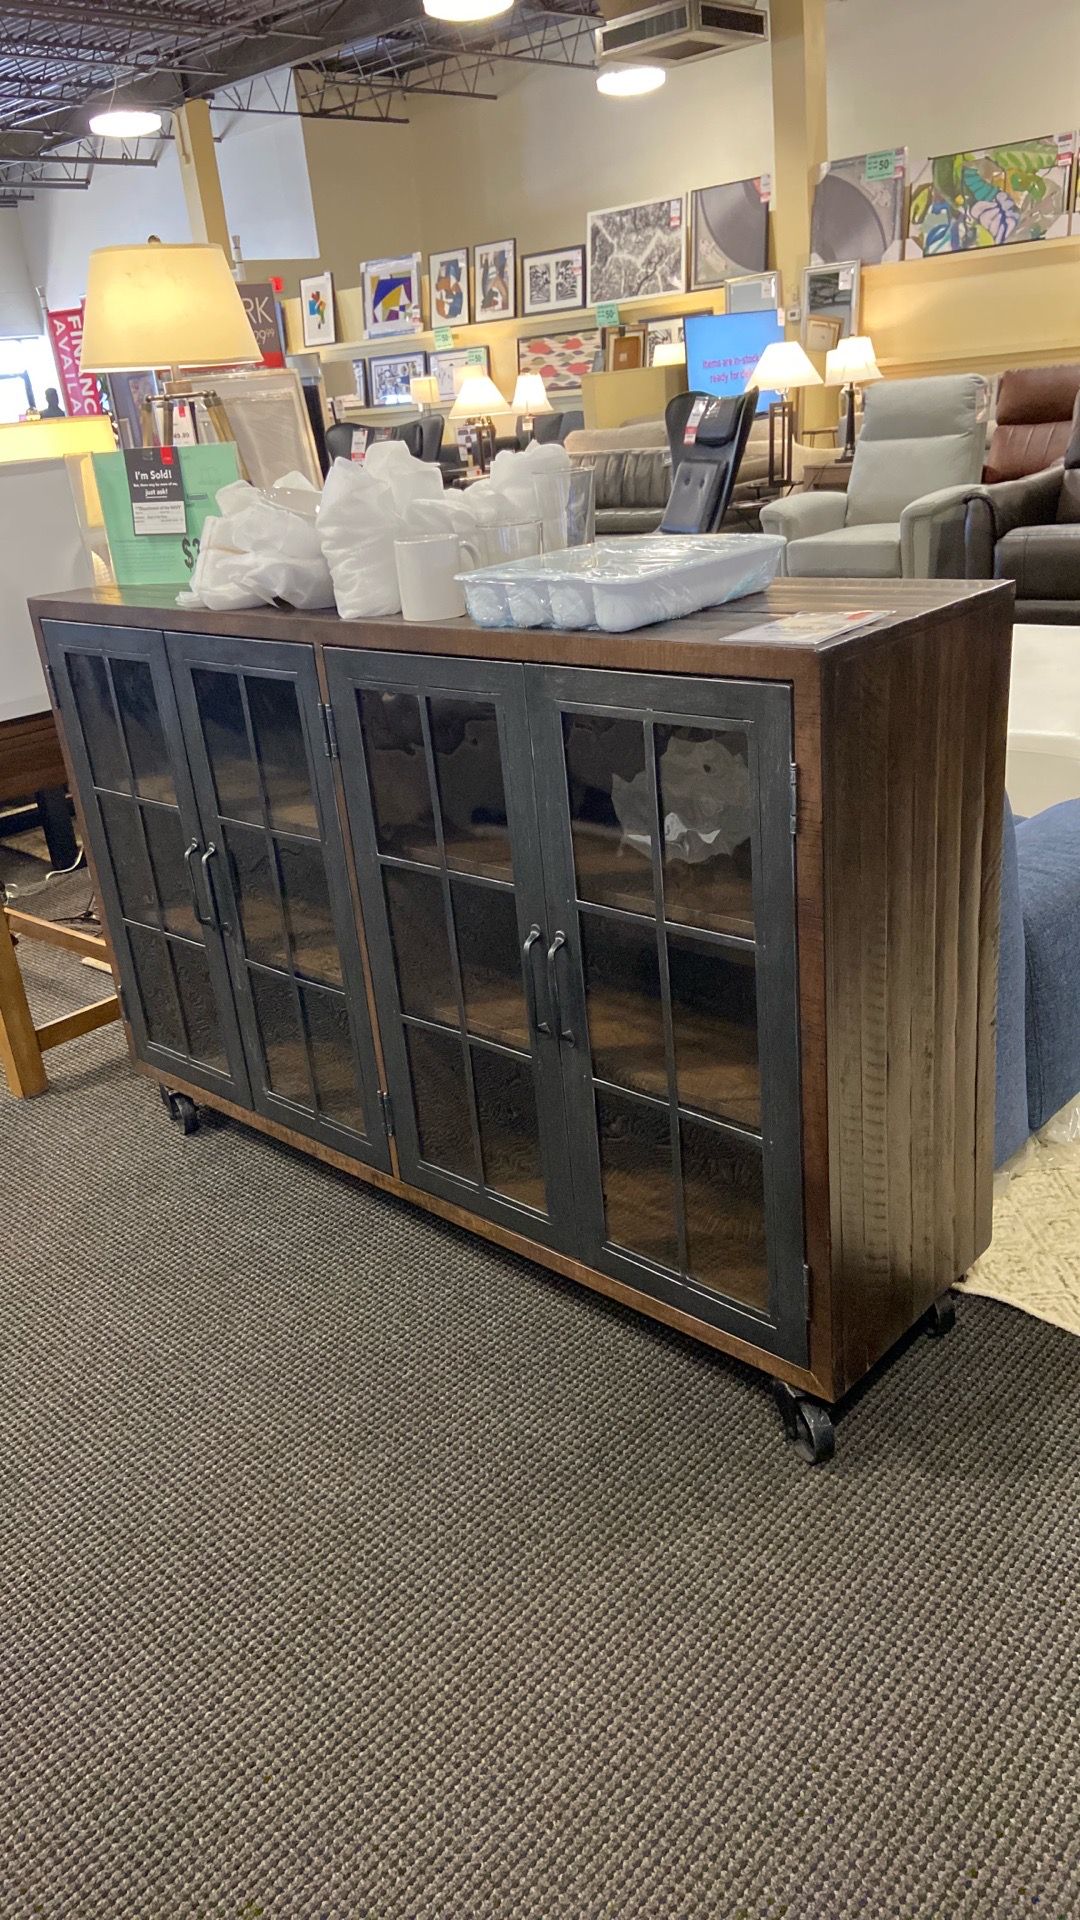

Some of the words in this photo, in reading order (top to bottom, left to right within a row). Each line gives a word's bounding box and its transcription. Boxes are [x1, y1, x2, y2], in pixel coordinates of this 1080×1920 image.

[67, 314, 97, 414] FINNC
[722, 358, 733, 367] are
[710, 374, 728, 384] ready
[730, 371, 740, 380] for
[134, 470, 149, 481] I'm
[150, 469, 173, 480] Sold!
[145, 487, 156, 497] just
[156, 487, 168, 496] ask!
